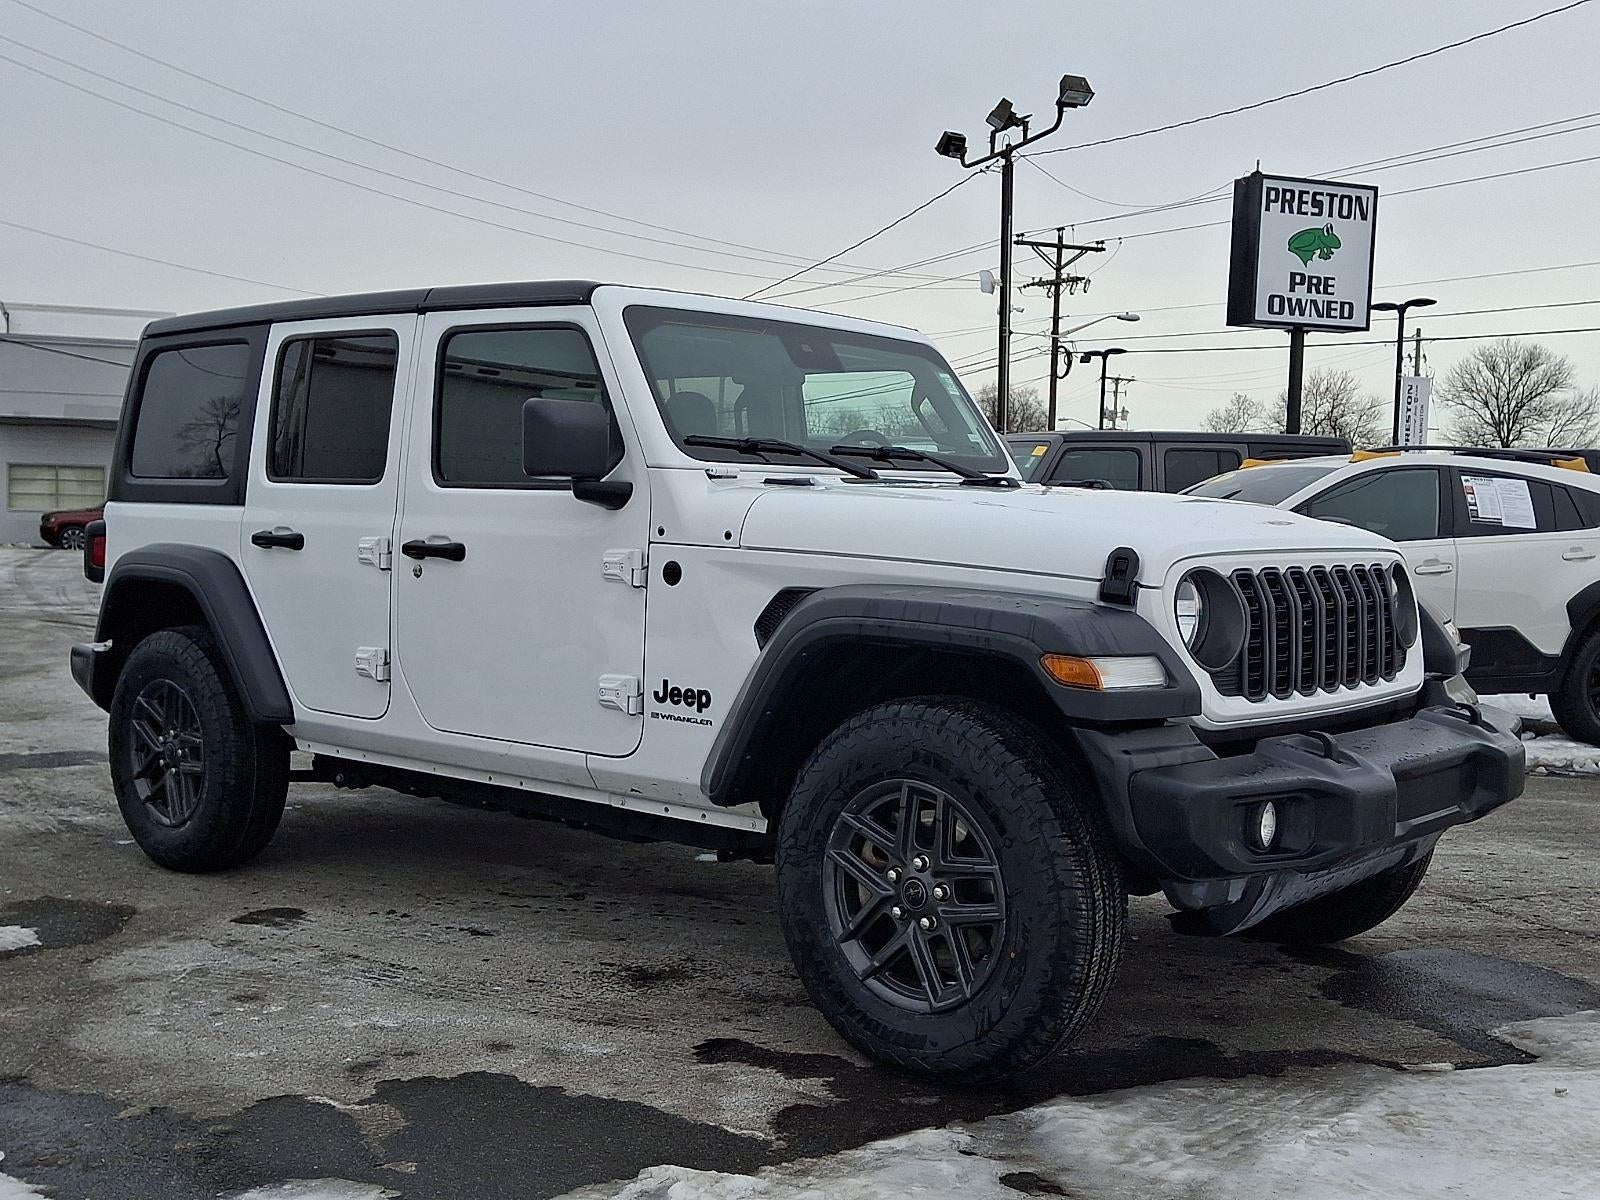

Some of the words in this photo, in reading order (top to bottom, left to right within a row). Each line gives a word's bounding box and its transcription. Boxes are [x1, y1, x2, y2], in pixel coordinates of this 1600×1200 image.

[1264, 186, 1370, 221] PRESTON
[1288, 271, 1336, 296] PRE
[1267, 294, 1354, 320] OWNED
[653, 678, 712, 714] Jeep
[660, 712, 713, 727] WRANGLER
